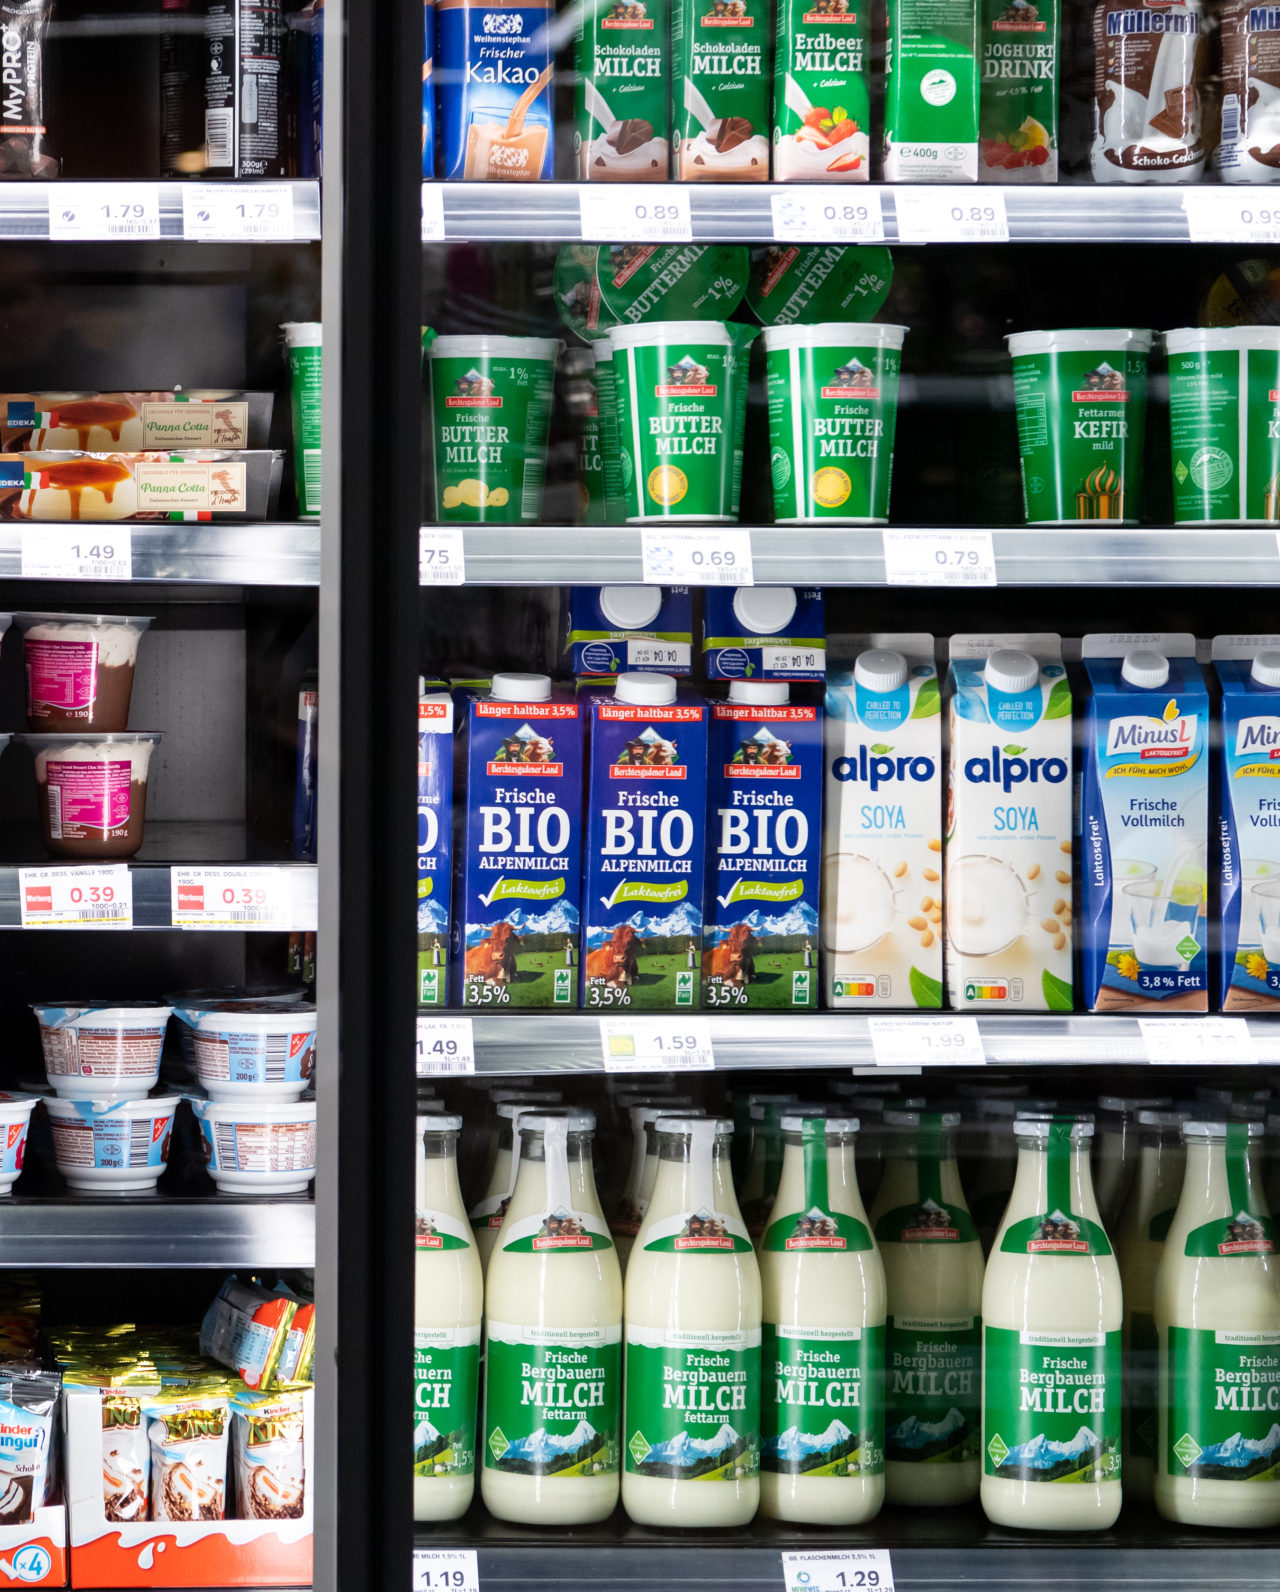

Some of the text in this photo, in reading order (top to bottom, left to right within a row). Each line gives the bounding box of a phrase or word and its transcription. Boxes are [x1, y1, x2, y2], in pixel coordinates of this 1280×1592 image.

[474, 34, 531, 44] Weihenstephan
[795, 33, 863, 50] Erdbeer
[479, 47, 526, 59] Frischer
[595, 45, 661, 56] Schokoladen
[693, 43, 761, 54] Schokoladen
[984, 44, 1054, 57] JOGHURT
[27, 41, 37, 88] PROTEIN
[984, 60, 1054, 78] DRINK
[466, 61, 540, 84] Kakao
[913, 147, 938, 159] 400g
[100, 204, 144, 218] 1.79
[635, 205, 679, 219] 0.89
[951, 207, 995, 221] 0.89
[509, 367, 529, 380] 1%
[456, 413, 489, 423] Frische
[1078, 408, 1125, 419] Fettarmer
[147, 420, 210, 433] Panna Cotta
[649, 415, 722, 435] BUTTER
[813, 418, 884, 438] BUTTER
[1073, 420, 1129, 439] KEFIR
[655, 437, 717, 456] MILCH
[819, 441, 878, 458] MILCH
[1092, 441, 1114, 451] mild
[140, 482, 206, 495] Panna Cotta
[70, 545, 115, 559] 1.49
[692, 551, 736, 566] 0.69
[479, 705, 576, 718] länger haltbar 3,5%
[866, 701, 900, 710] CHILLED TO
[999, 702, 1033, 710] CHILLED TO
[601, 707, 700, 720] länger haltbar 3,5%
[865, 710, 901, 720] PERFECTION
[998, 712, 1034, 720] PERFECTION
[491, 763, 558, 776] Berchtesgadener Land
[728, 766, 797, 778] Berchtesgadener Land
[832, 744, 935, 792] alpro
[1168, 764, 1188, 773] WOHL
[1130, 799, 1177, 811] Frische
[861, 805, 906, 829] SOYA
[1121, 815, 1184, 827] Vollmilch
[478, 807, 571, 854] BIO
[479, 856, 569, 871] ALPENMILCH
[601, 859, 692, 873] ALPENMILCH
[718, 858, 807, 873] ALPENMILCH
[70, 886, 114, 903] 0.39
[501, 882, 559, 896] Laktosefrei
[469, 974, 485, 983] Fett
[590, 977, 606, 986] Fett
[707, 975, 723, 984] Fett
[1142, 975, 1201, 989] 3,8 % Fett
[653, 1036, 698, 1050] 1.59
[531, 1330, 600, 1338] traditionell hergestellt
[672, 1332, 742, 1342] traditionell hergestellt
[796, 1350, 840, 1363] Frische
[1239, 1356, 1278, 1369] Frische
[1042, 1357, 1087, 1370] Frische
[521, 1364, 606, 1380] Bergbauern
[774, 1363, 861, 1380] Bergbauern
[542, 1408, 587, 1421] fettarm
[684, 1411, 730, 1424] fettarm
[836, 1571, 880, 1587] 1.29
